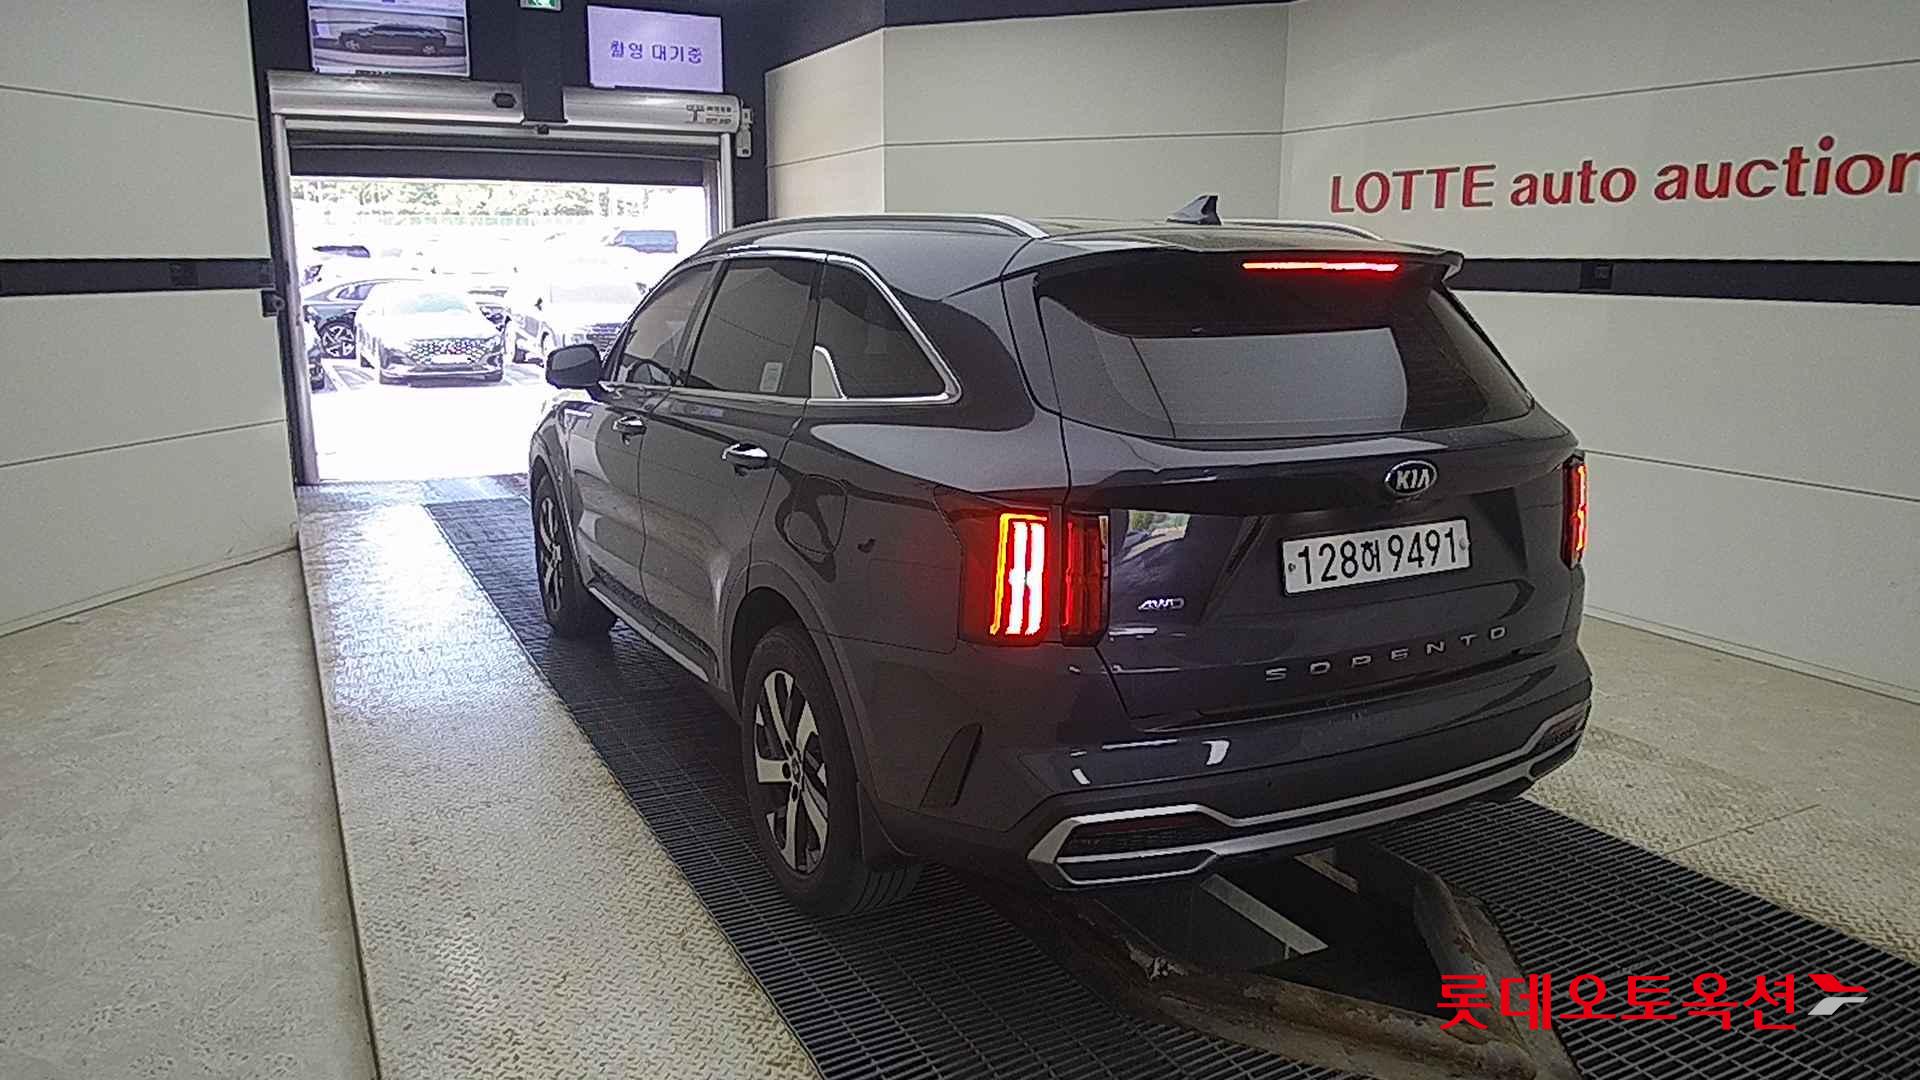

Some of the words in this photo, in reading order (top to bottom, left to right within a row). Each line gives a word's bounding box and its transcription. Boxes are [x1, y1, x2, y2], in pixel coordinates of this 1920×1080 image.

[610, 40, 643, 60] 촬영
[651, 44, 702, 64] 대기중
[1331, 164, 1497, 213] LOTTE
[1510, 159, 1637, 206] auto
[1396, 468, 1430, 490] KIA
[1138, 598, 1184, 610] AWD
[1265, 626, 1506, 681] SORENTO
